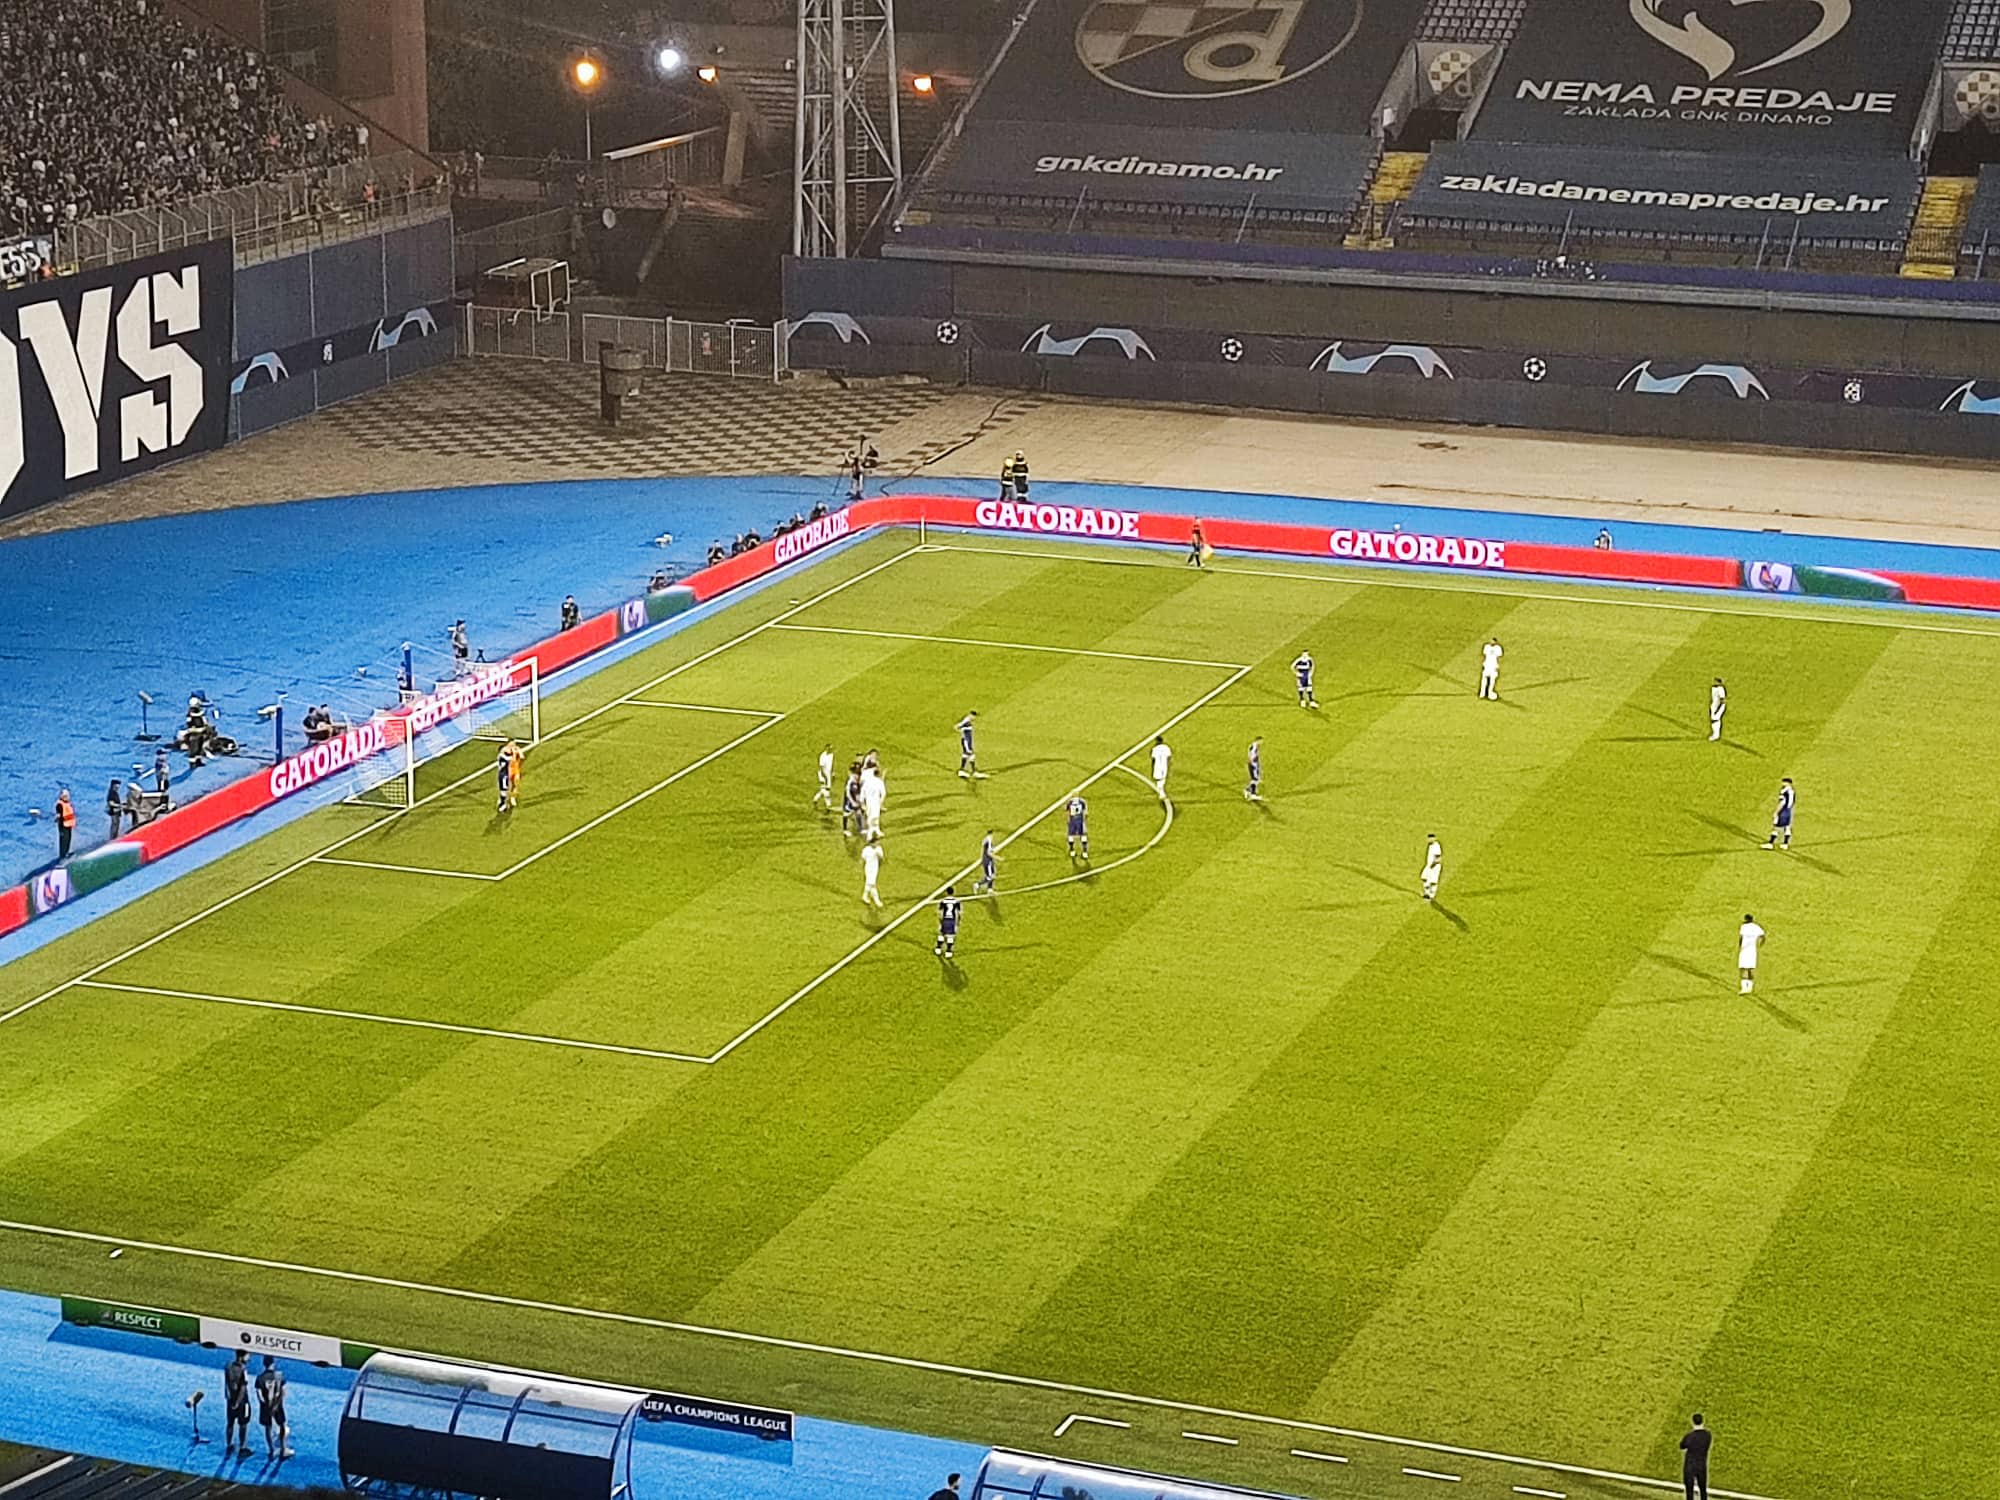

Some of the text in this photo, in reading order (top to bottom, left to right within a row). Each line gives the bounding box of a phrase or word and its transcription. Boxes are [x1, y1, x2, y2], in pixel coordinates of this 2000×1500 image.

[1516, 79, 1896, 113] NEMA PREDAJE
[1563, 104, 1833, 126] ZAKLADA GNK DINAMO
[1035, 155, 1283, 181] gnkdinamo.hr
[1439, 174, 1888, 214] zakladanemapredaje.hr
[774, 508, 849, 563] GATORADE
[974, 501, 1139, 537] GATORADE
[1329, 530, 1505, 568] GATORADE
[269, 719, 386, 798] GATORADE
[114, 1311, 162, 1330] RESPECT
[254, 1335, 302, 1352] RESPECT
[642, 1400, 788, 1432] UEFA CHAMPIONS LEAGUE
